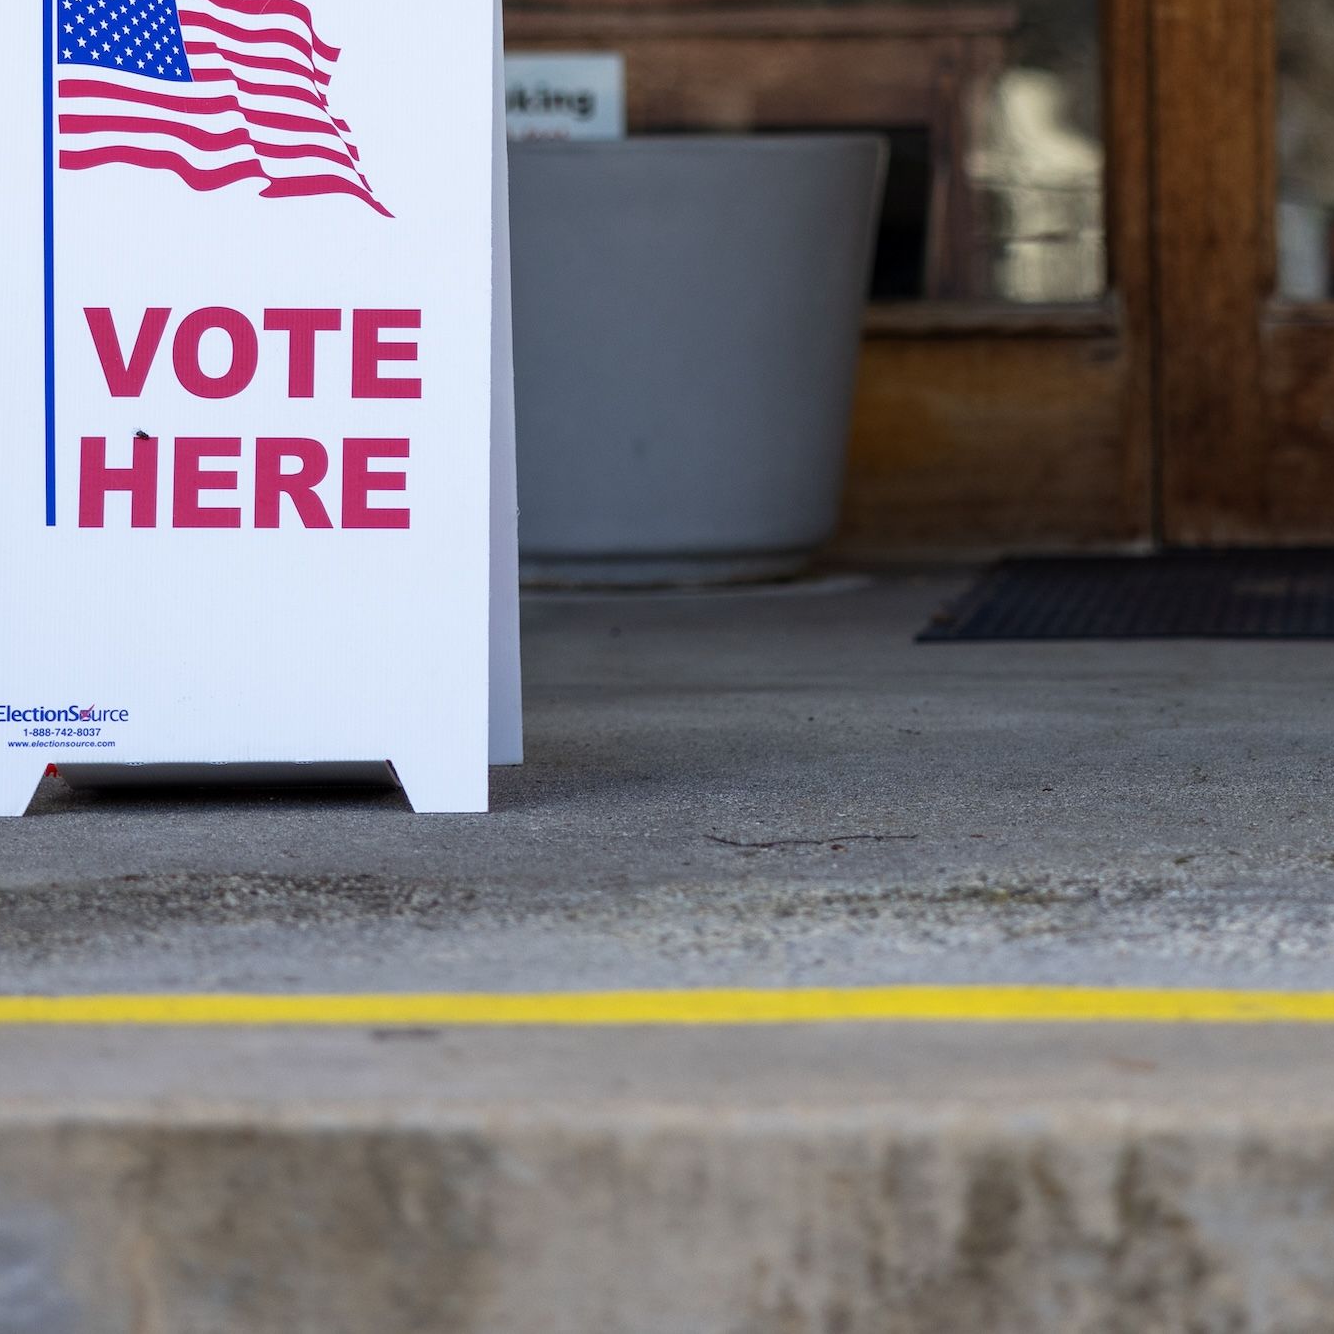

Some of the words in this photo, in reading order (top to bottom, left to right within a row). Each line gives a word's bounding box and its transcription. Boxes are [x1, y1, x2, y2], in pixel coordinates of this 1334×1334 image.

[83, 306, 422, 399] VOTE
[78, 436, 410, 529] HERE
[8, 740, 116, 748] www.electionsource.com
[23, 728, 101, 737] 1-888-742-8037
